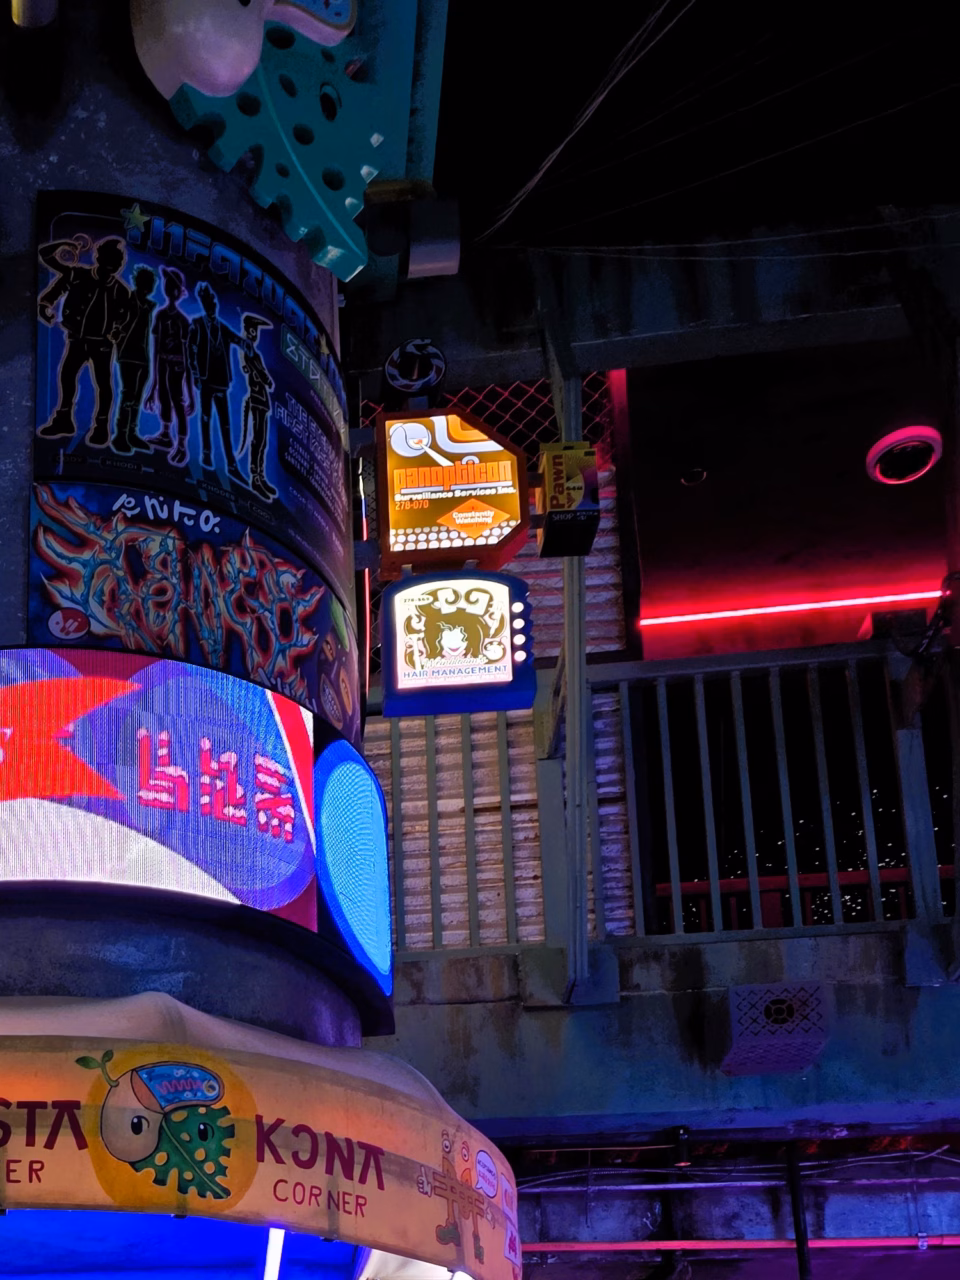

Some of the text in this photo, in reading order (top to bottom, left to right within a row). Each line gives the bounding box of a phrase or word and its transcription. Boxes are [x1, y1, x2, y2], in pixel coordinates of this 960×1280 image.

[394, 459, 512, 493] panopticon
[549, 453, 564, 511] Pawn
[394, 490, 453, 501] Surveillance
[454, 488, 496, 498] Services
[452, 510, 494, 520] Constantly
[455, 517, 492, 525] Watching
[403, 670, 428, 679] HAIR
[431, 664, 507, 677] MANAGEMENT
[272, 1178, 368, 1219] CORNER
